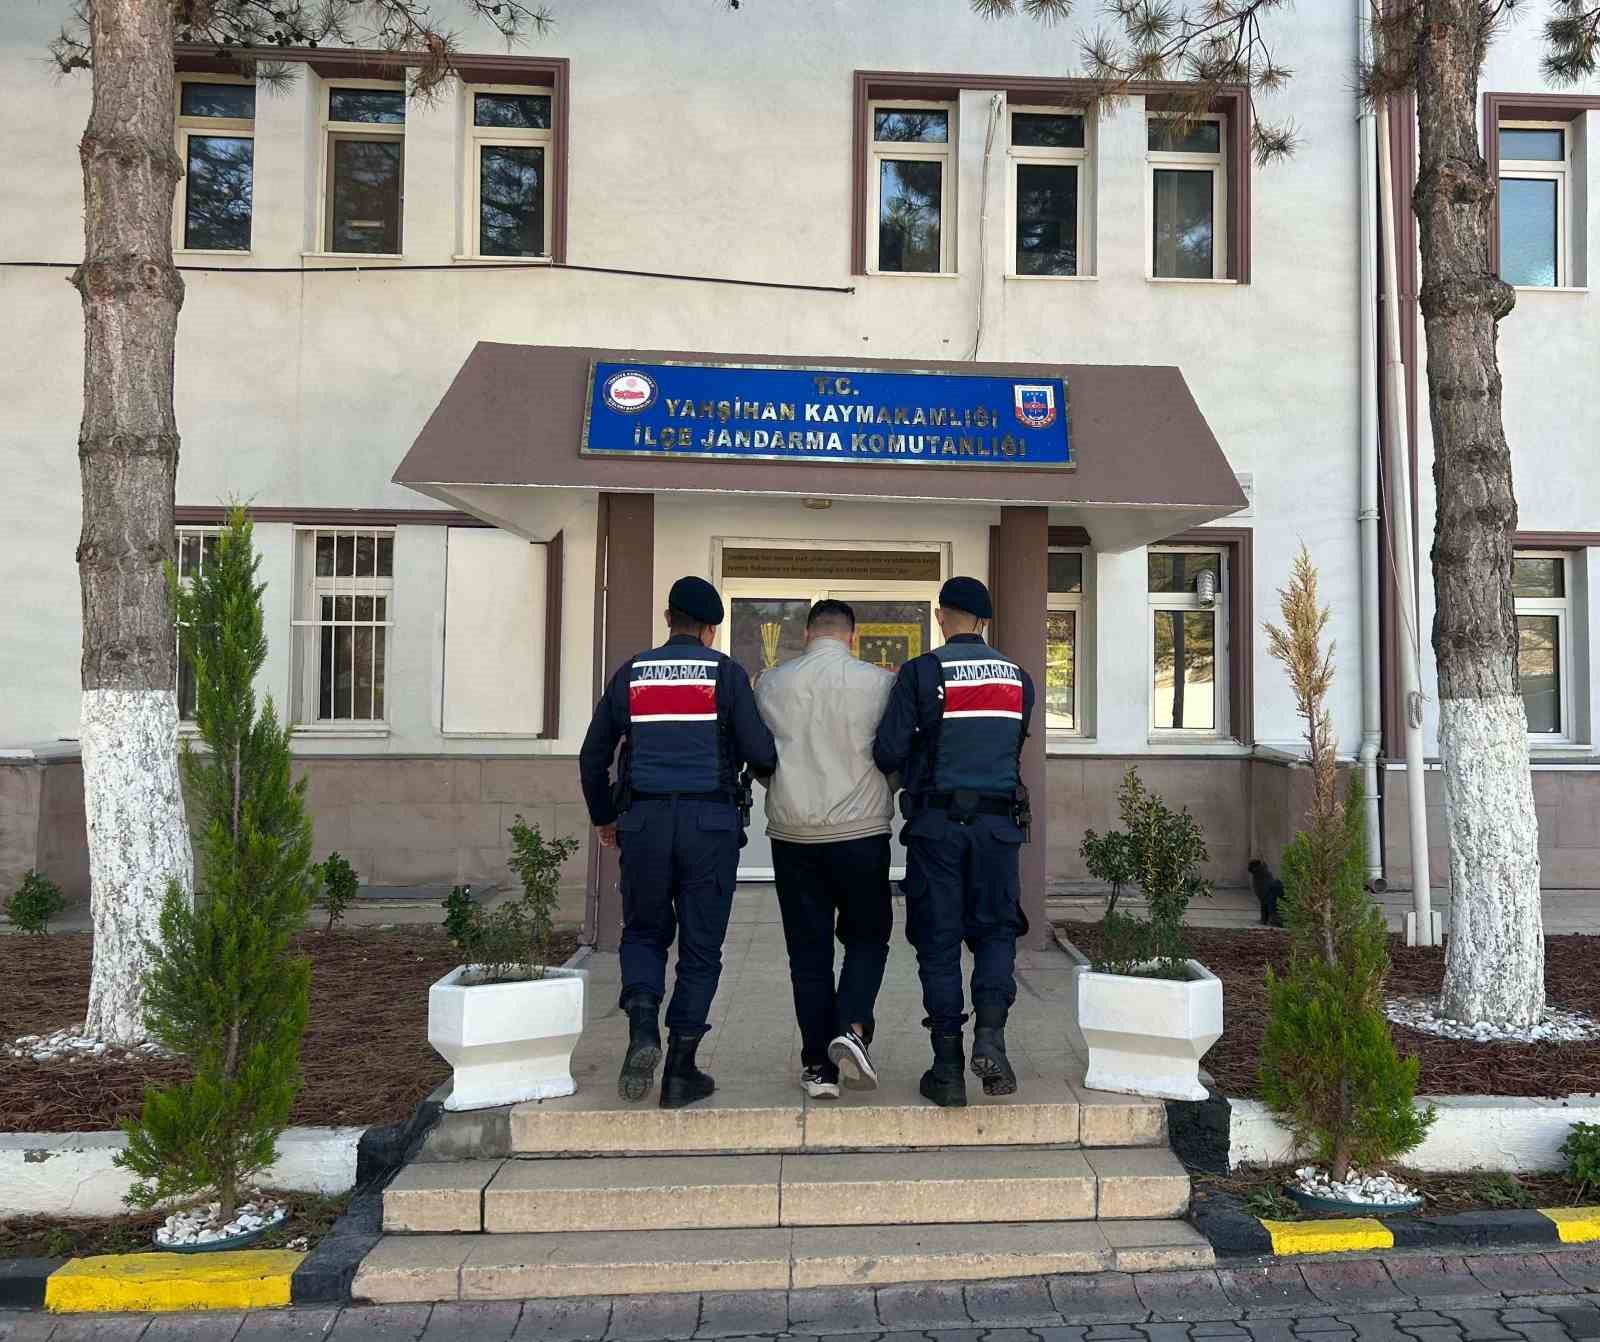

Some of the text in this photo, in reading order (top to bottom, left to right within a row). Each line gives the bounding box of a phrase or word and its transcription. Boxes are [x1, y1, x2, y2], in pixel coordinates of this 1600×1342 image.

[813, 376, 859, 395] T.C.
[664, 397, 796, 423] YAHŞİHAN
[804, 403, 999, 429] KAYMAKAMLIĞI
[634, 422, 1025, 457] İLÇE JANDARMA KOMUTANLIĞI
[638, 664, 708, 681] JANDARMA
[953, 663, 1017, 681] JANDARMA
